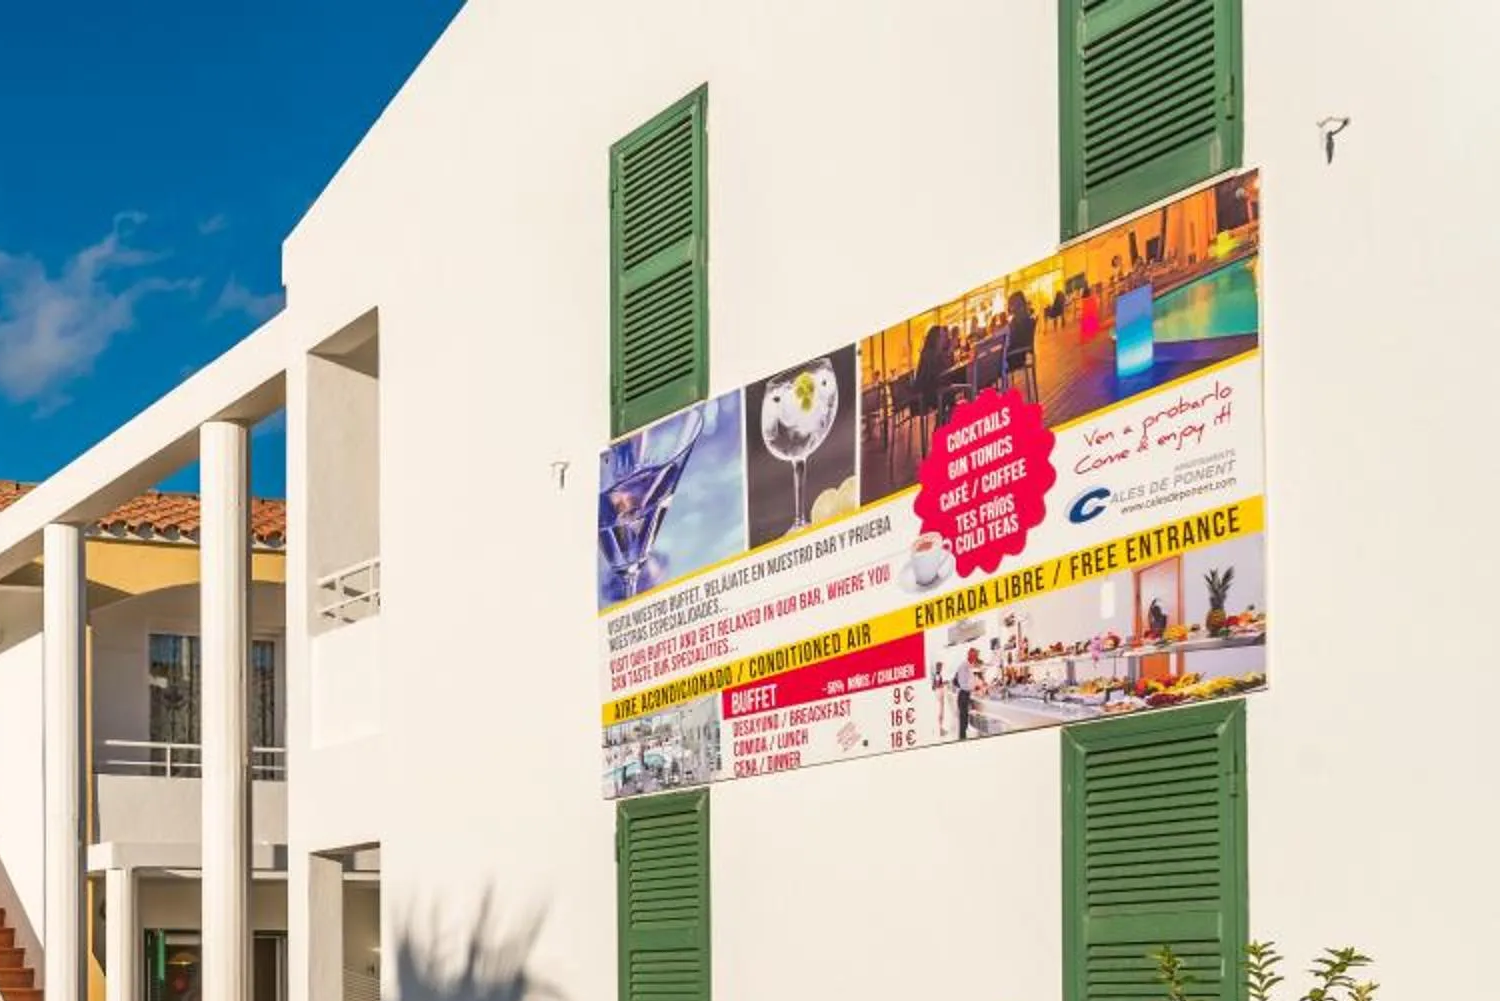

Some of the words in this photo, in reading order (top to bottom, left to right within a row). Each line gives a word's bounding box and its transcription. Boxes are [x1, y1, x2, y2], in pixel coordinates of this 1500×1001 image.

[947, 407, 1011, 453] COCKTAILS
[1142, 380, 1233, 438] probarlo
[948, 455, 968, 480] GIN
[970, 435, 1013, 469] TONICS
[1074, 450, 1129, 474] Come
[1157, 424, 1205, 450] enjoy
[939, 480, 970, 512] CAFÉ
[981, 458, 1027, 493] COFFEE
[1149, 477, 1170, 494] DE
[1173, 460, 1236, 489] PONENT
[955, 528, 985, 555] COLD
[988, 514, 1020, 541] TEAS
[956, 509, 978, 533] TES
[751, 562, 765, 580] EN
[767, 544, 813, 574] NUESTRO
[815, 538, 837, 557] BAR
[839, 534, 846, 549] Y
[850, 515, 892, 545] PRUEBA
[614, 699, 637, 721] AIRE
[641, 665, 732, 710] ACONDICIONADO
[750, 633, 841, 678] CONDITIONED
[847, 624, 872, 649] AIR
[915, 585, 988, 628] ENTRADA
[995, 571, 1044, 605] LIBRE
[1052, 560, 1061, 585] /
[1070, 544, 1117, 581] FREE
[1127, 506, 1240, 563] ENTRANCE
[647, 637, 677, 660] BUFFET
[680, 630, 696, 648] AND
[699, 624, 715, 643] GET
[717, 606, 761, 637] RELAXED
[764, 604, 774, 623] IN
[777, 595, 797, 617] OUR
[827, 572, 864, 600] WHERE
[868, 563, 890, 586] YOU
[654, 658, 670, 676] OUR
[731, 684, 777, 715] BUFFET
[893, 687, 901, 704] 9
[904, 685, 915, 702] €
[778, 728, 809, 749] LUNCH
[891, 709, 903, 727] 16
[905, 707, 916, 724] €
[891, 731, 903, 748] 16
[905, 729, 916, 746] €
